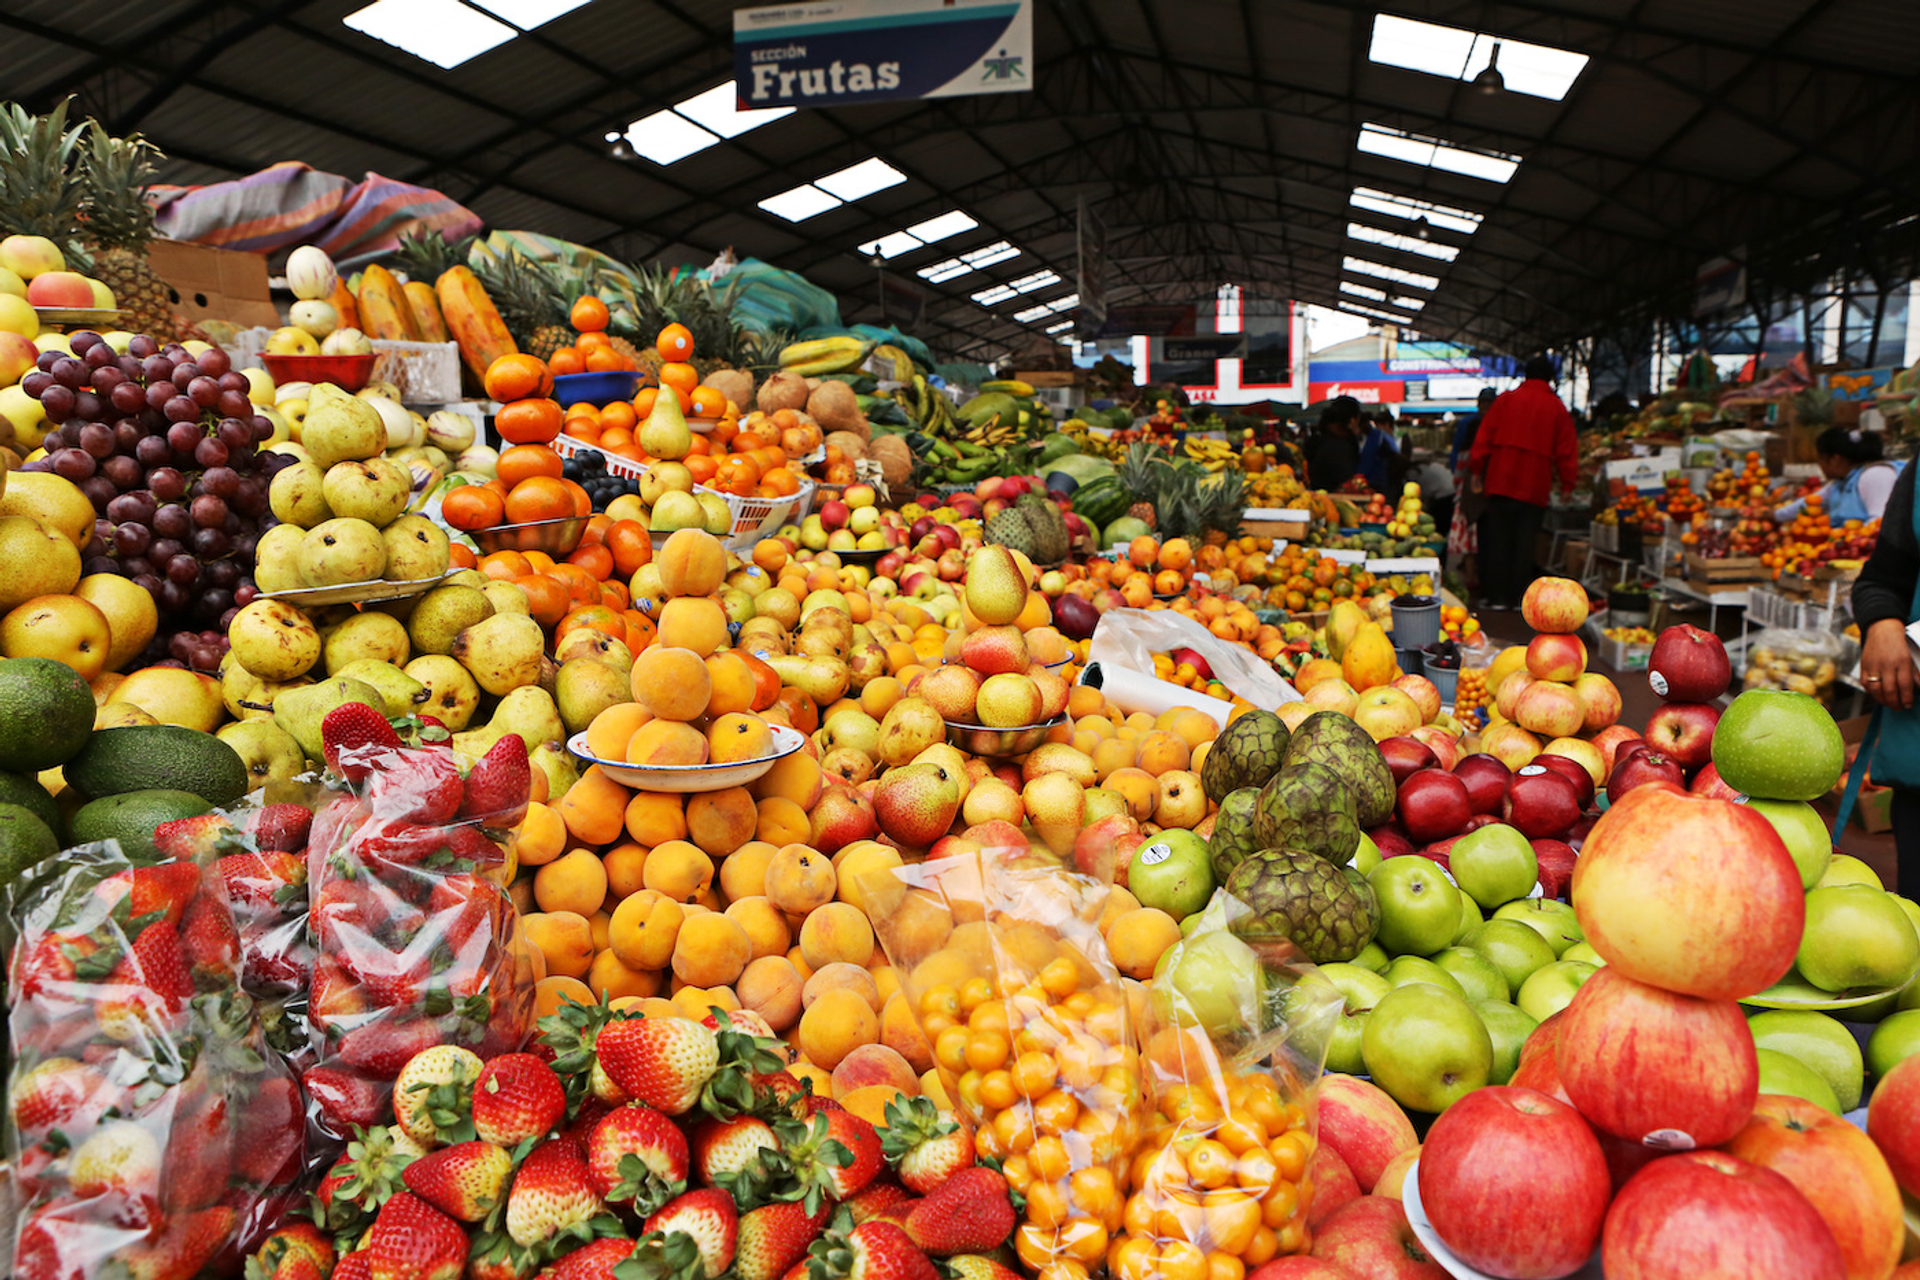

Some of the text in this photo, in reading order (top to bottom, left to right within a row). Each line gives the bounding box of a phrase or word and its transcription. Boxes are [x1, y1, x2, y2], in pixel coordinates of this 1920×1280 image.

[751, 43, 807, 62] SECCIÓN
[751, 60, 900, 100] Frutas
[1168, 348, 1217, 359] Granos
